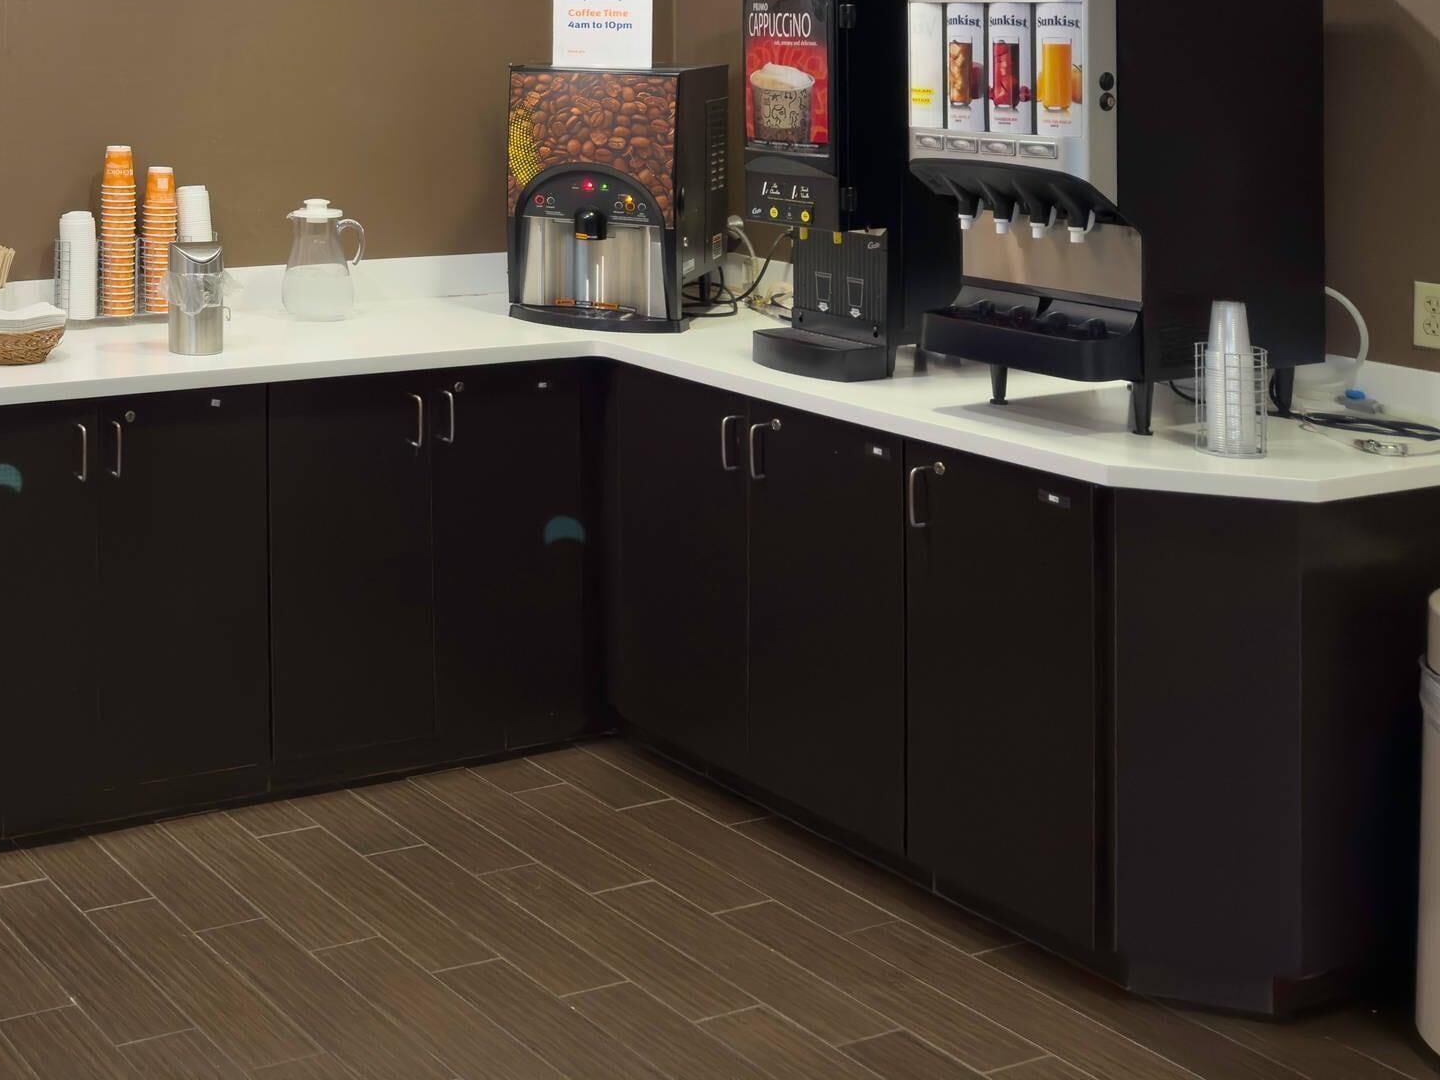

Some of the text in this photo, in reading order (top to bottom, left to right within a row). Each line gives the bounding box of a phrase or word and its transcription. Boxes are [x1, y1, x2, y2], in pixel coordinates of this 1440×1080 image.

[568, 8, 629, 17] Coffee Time
[568, 21, 632, 31] 4am to 10pm
[989, 14, 1029, 29] Sunkist
[1037, 14, 1080, 29] Sunkist
